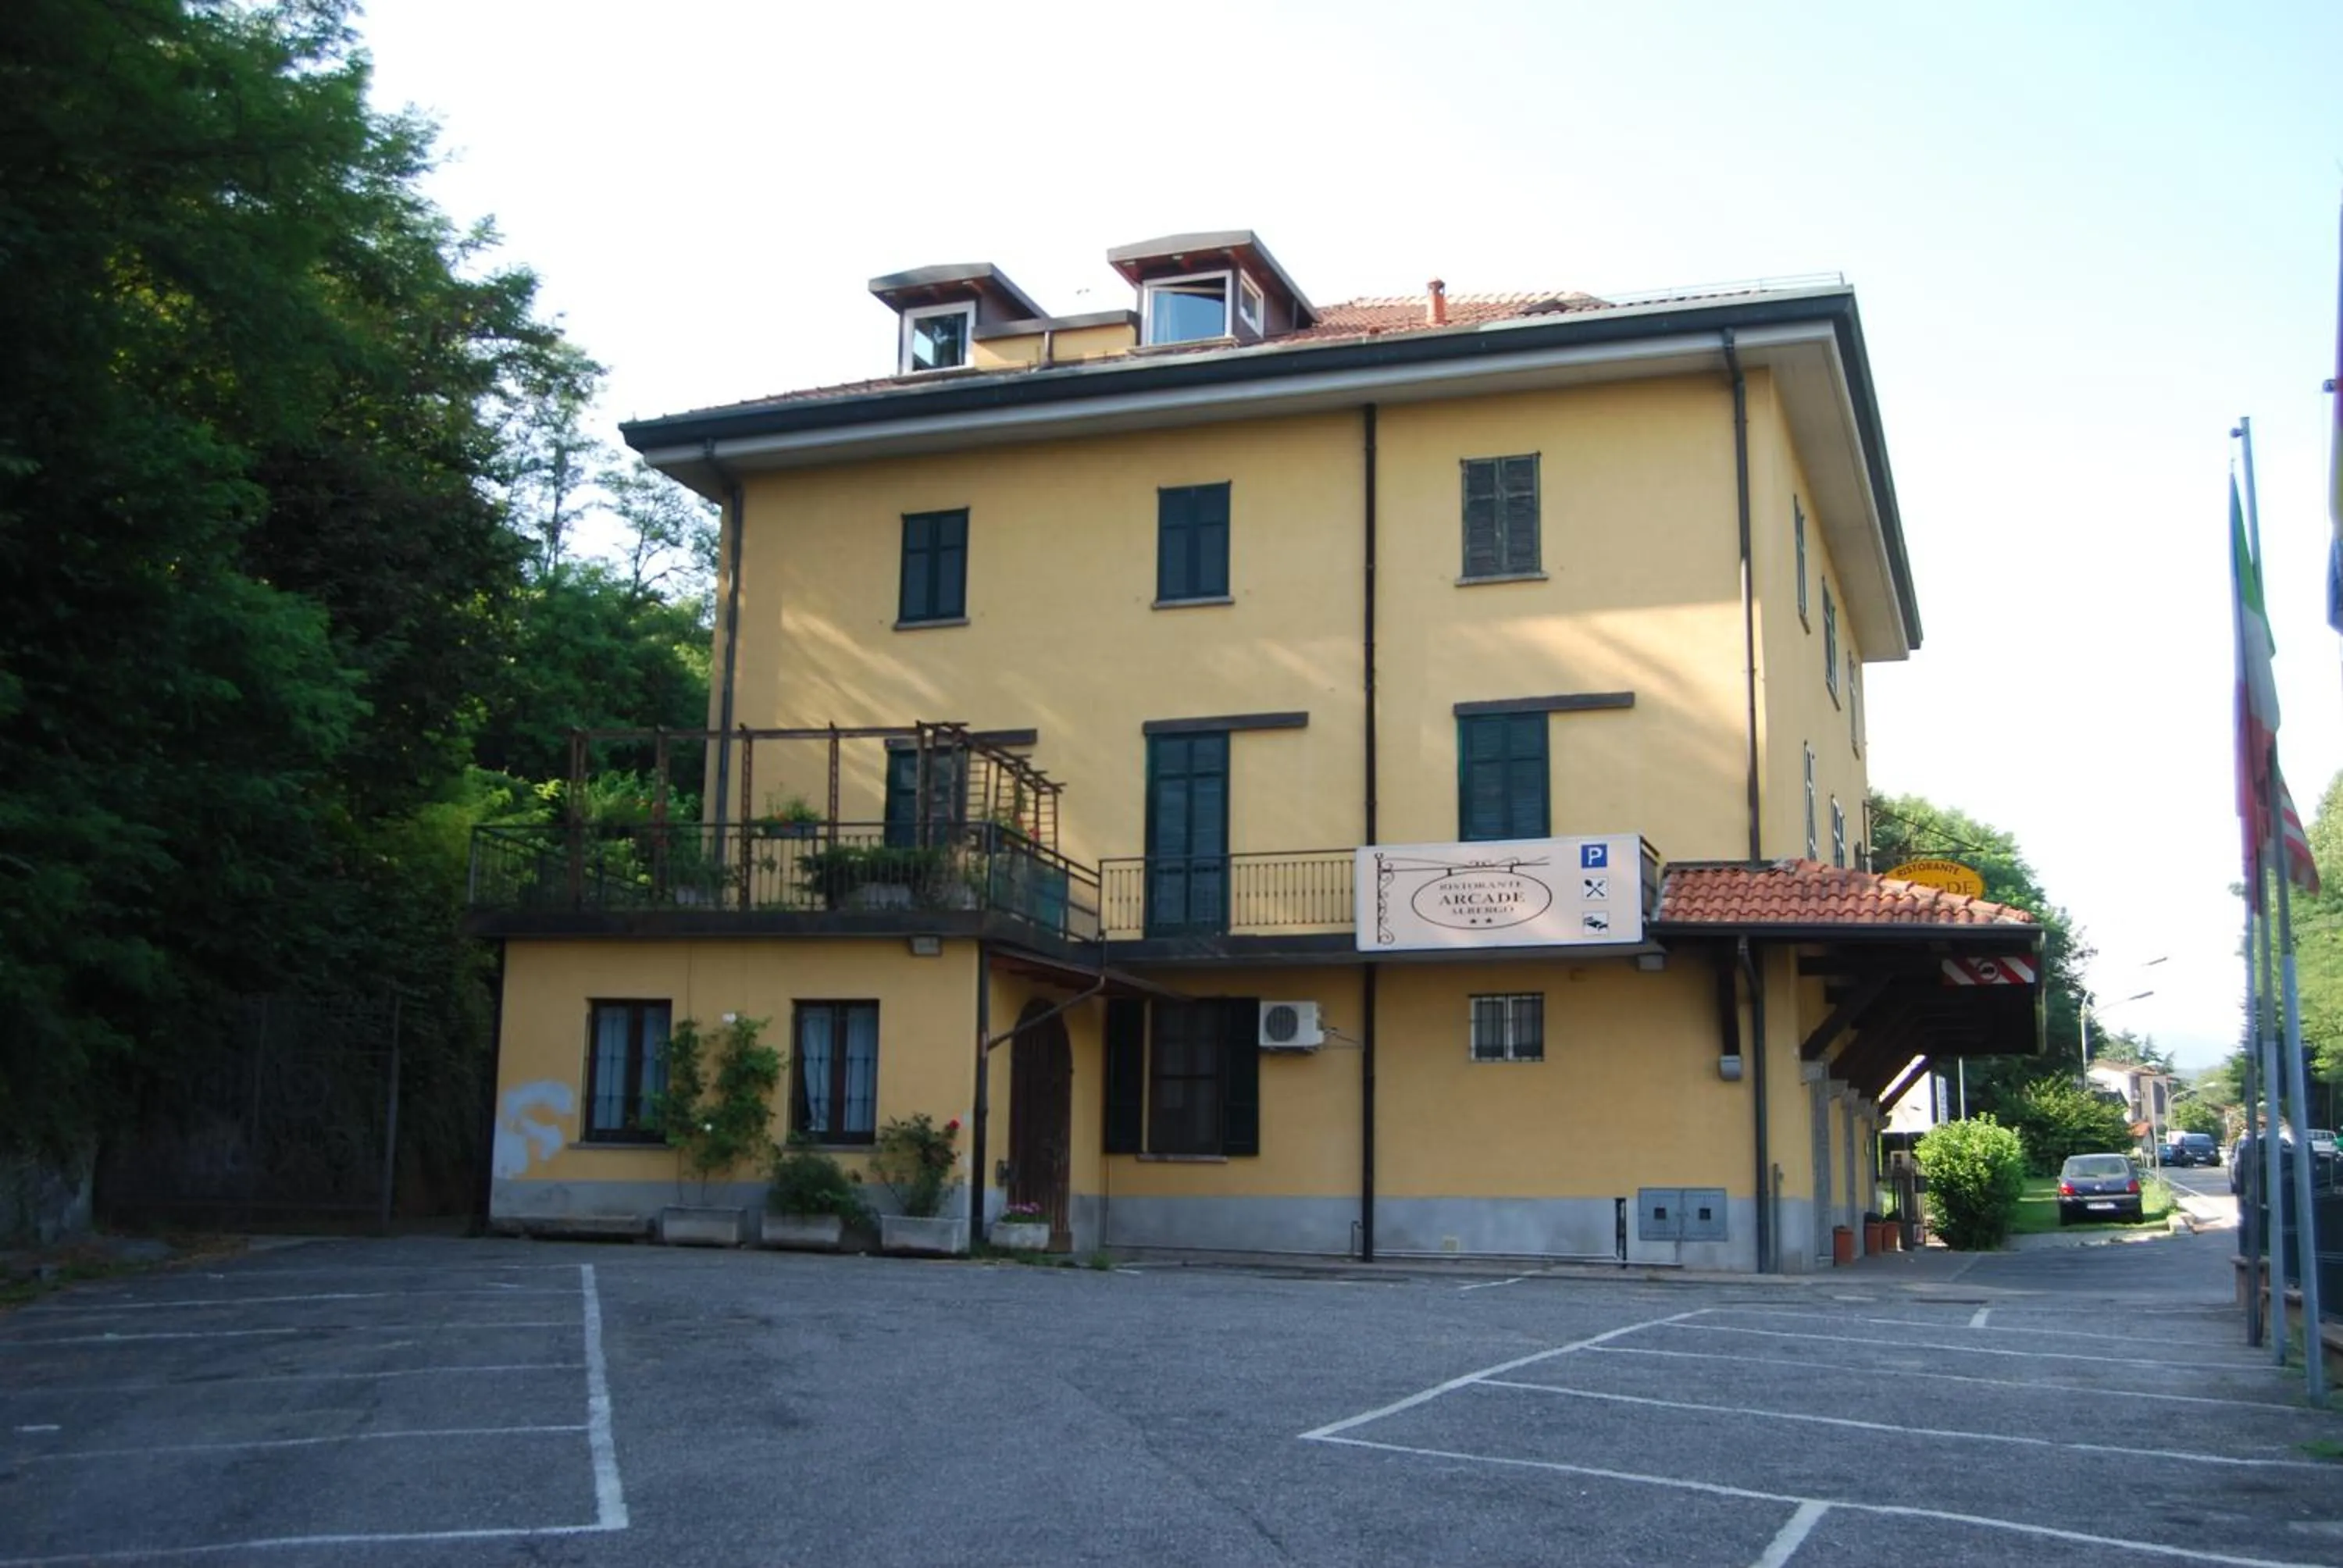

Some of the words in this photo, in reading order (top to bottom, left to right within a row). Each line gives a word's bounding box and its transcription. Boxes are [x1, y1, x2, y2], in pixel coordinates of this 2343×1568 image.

[1588, 847, 1602, 864] P
[1897, 862, 1960, 876] RISTORANTE
[1439, 881, 1522, 890] RISTORANTE
[1439, 892, 1525, 906] ARCADE
[1452, 906, 1515, 915] ALBERGO
